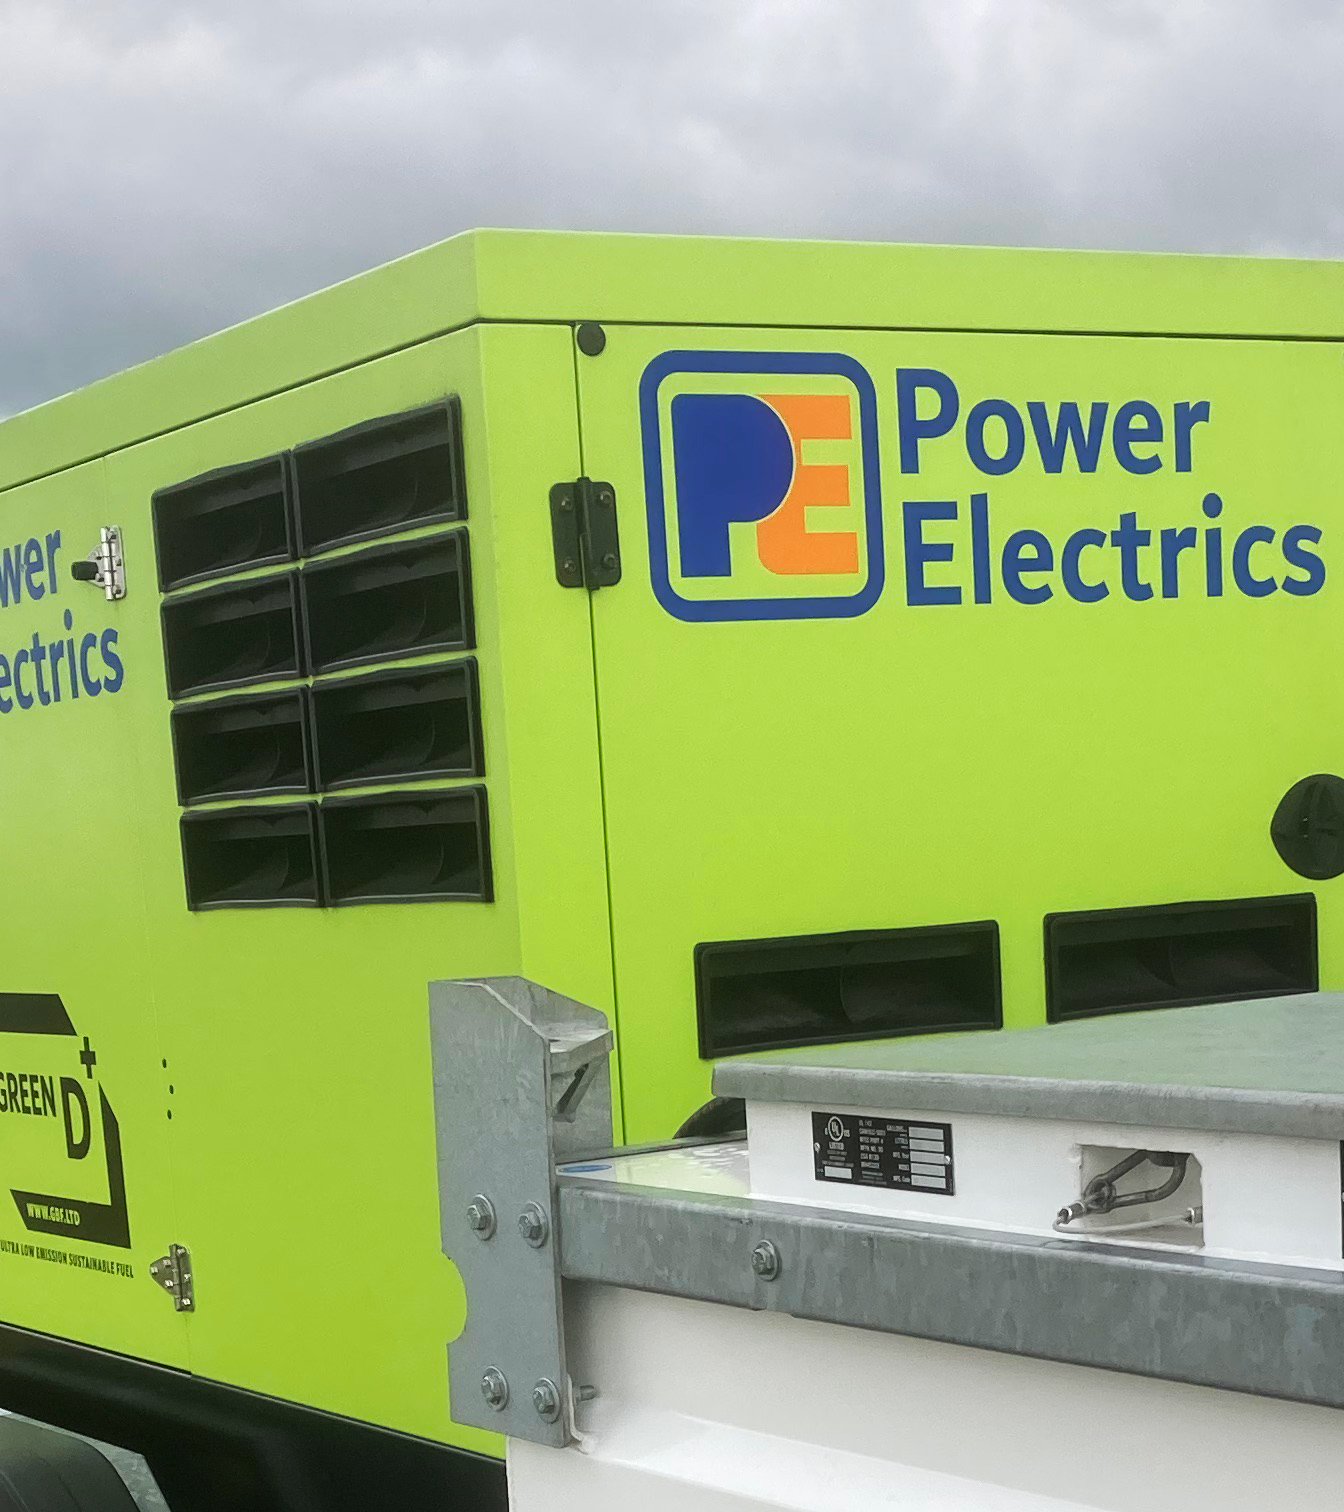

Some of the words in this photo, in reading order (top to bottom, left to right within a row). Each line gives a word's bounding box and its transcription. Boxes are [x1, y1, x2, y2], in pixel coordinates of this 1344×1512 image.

[896, 368, 1210, 476] Power
[902, 492, 1326, 607] Electrics
[0, 1239, 19, 1253] ULTRA
[21, 1244, 34, 1257] LOW
[36, 1247, 68, 1264] EMISSION
[68, 1253, 115, 1275] SUSTAINABLE
[116, 1262, 134, 1278] FUEL
